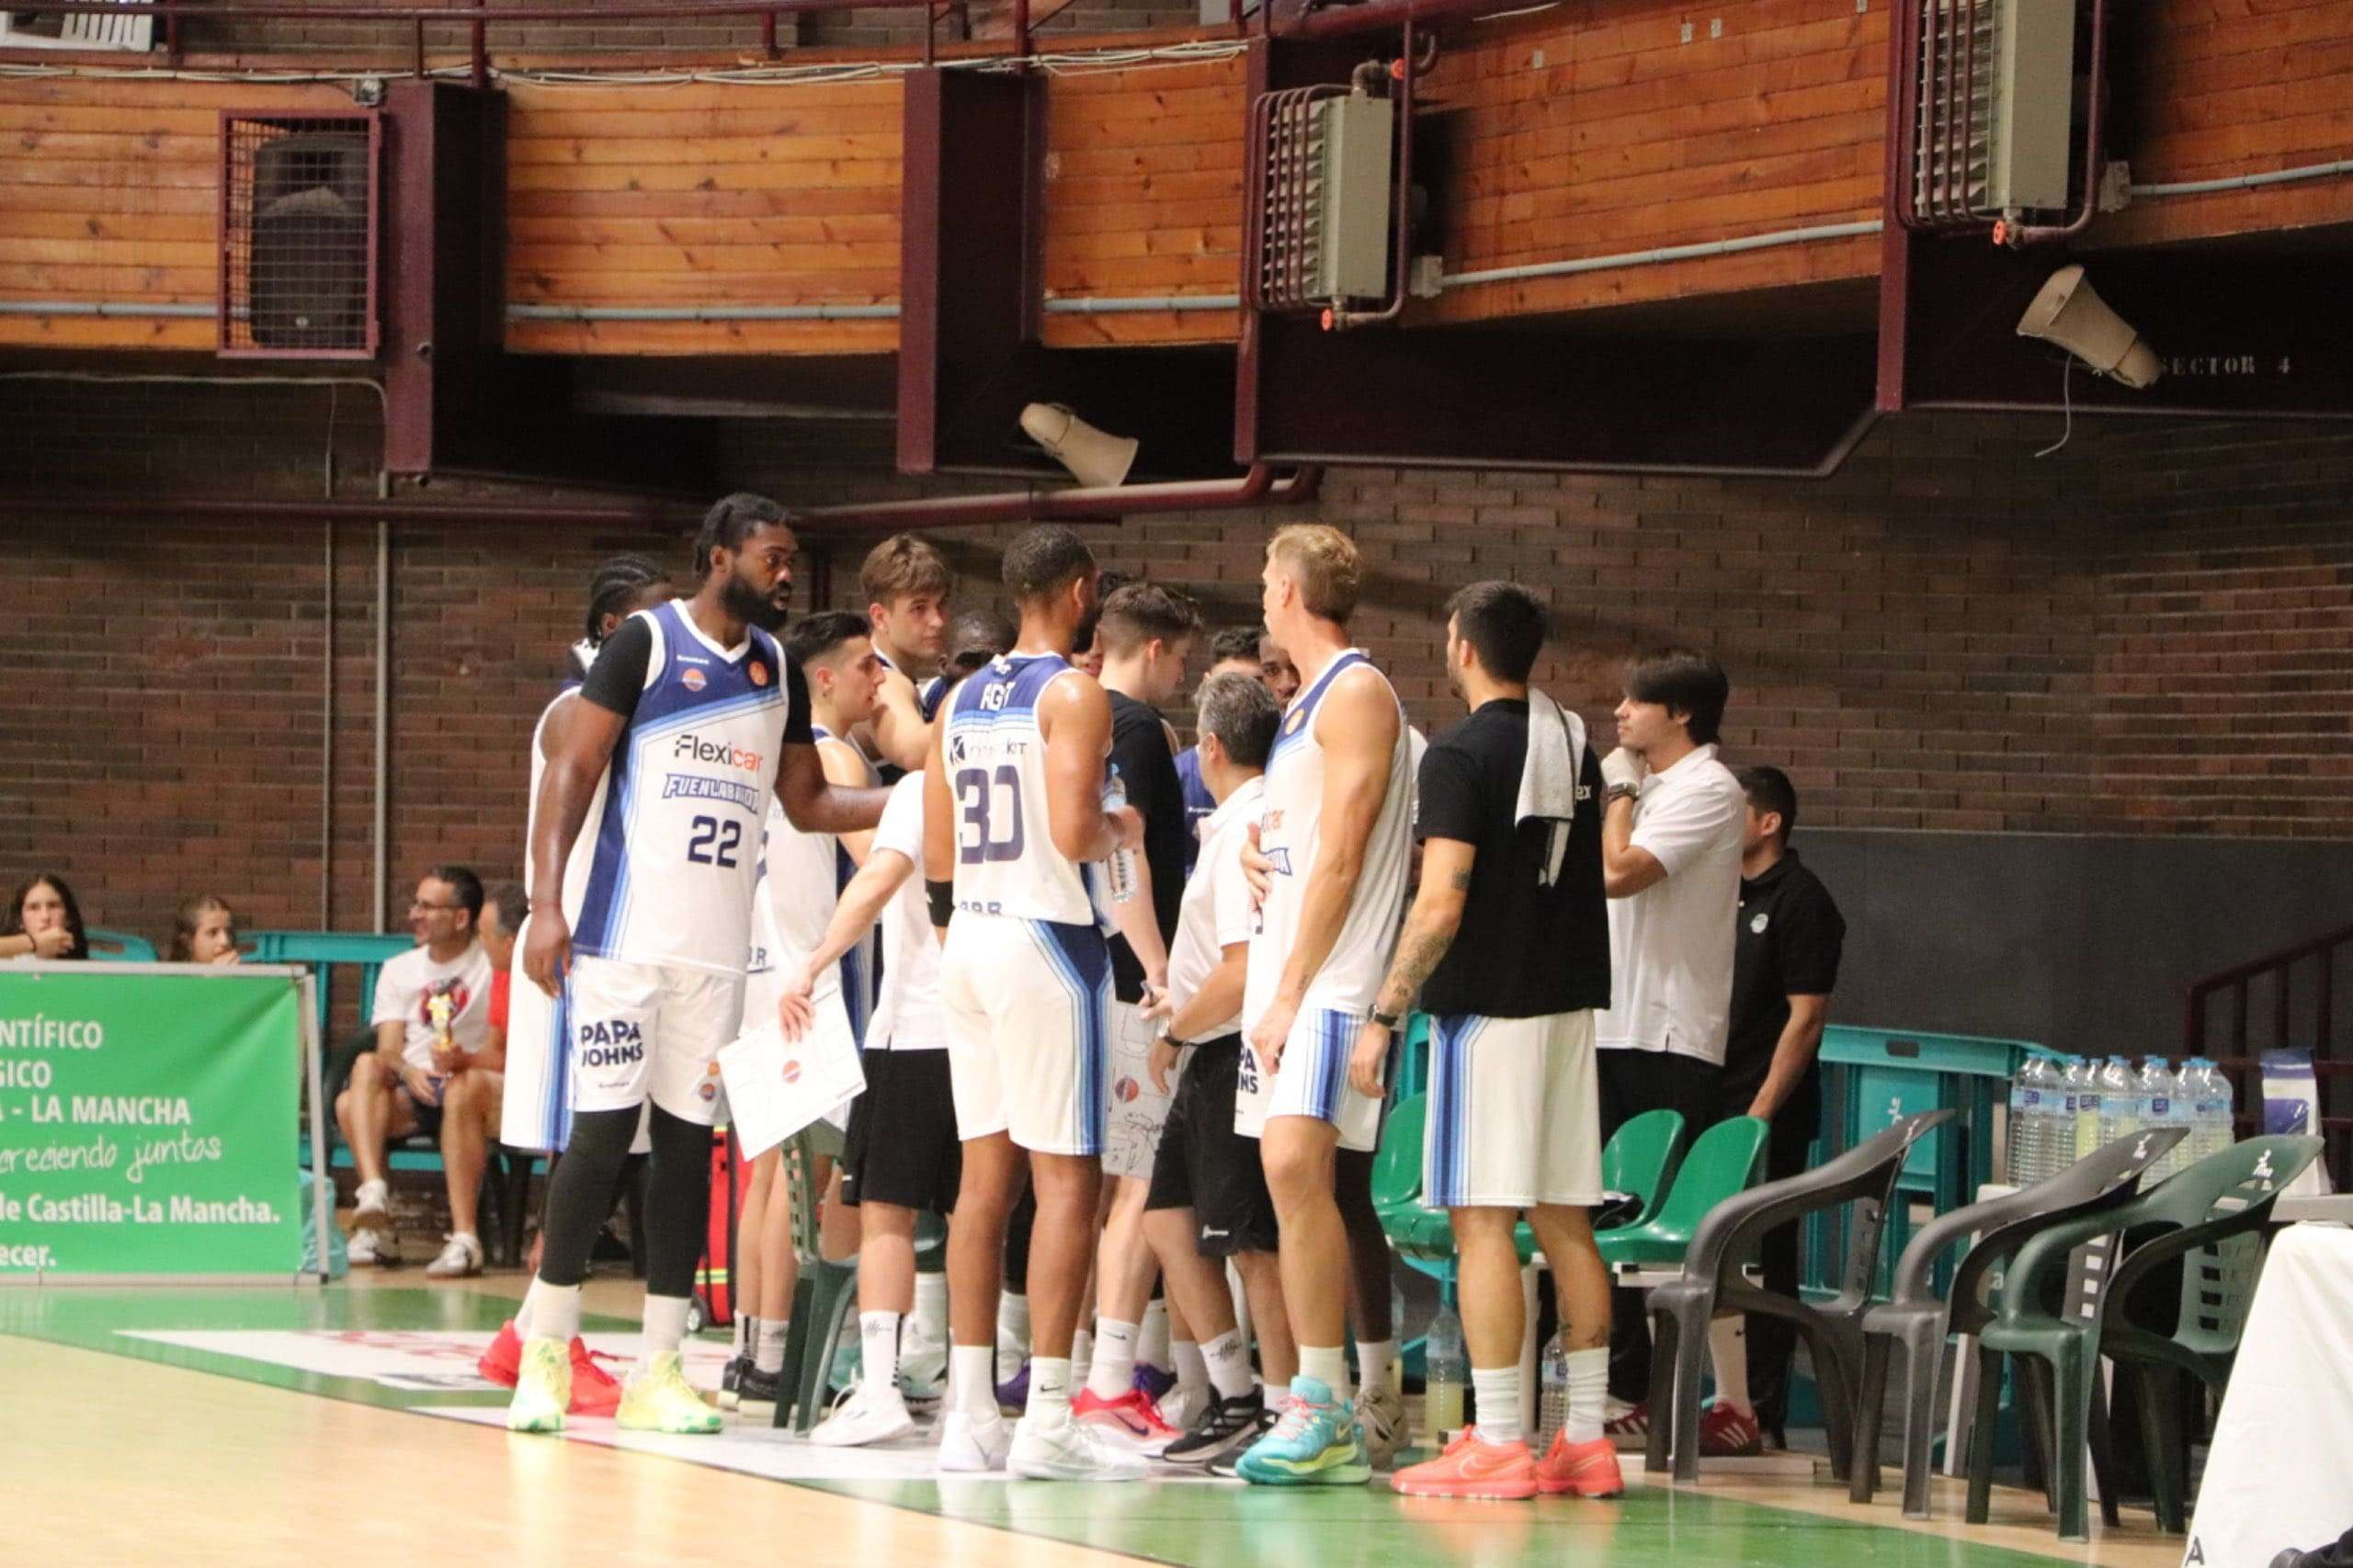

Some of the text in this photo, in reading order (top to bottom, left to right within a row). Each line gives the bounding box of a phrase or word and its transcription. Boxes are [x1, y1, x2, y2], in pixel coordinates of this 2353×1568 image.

[2277, 357, 2290, 374] 4
[674, 734, 764, 773] Flexicar
[956, 765, 1025, 865] 30
[688, 814, 742, 869] 22
[581, 1019, 642, 1045] PAPA
[31, 1095, 63, 1122] LA
[73, 1095, 191, 1125] MANCHA
[126, 1129, 222, 1184] juntos
[27, 1193, 163, 1223] Castilla-La
[170, 1194, 280, 1223] Mancha.
